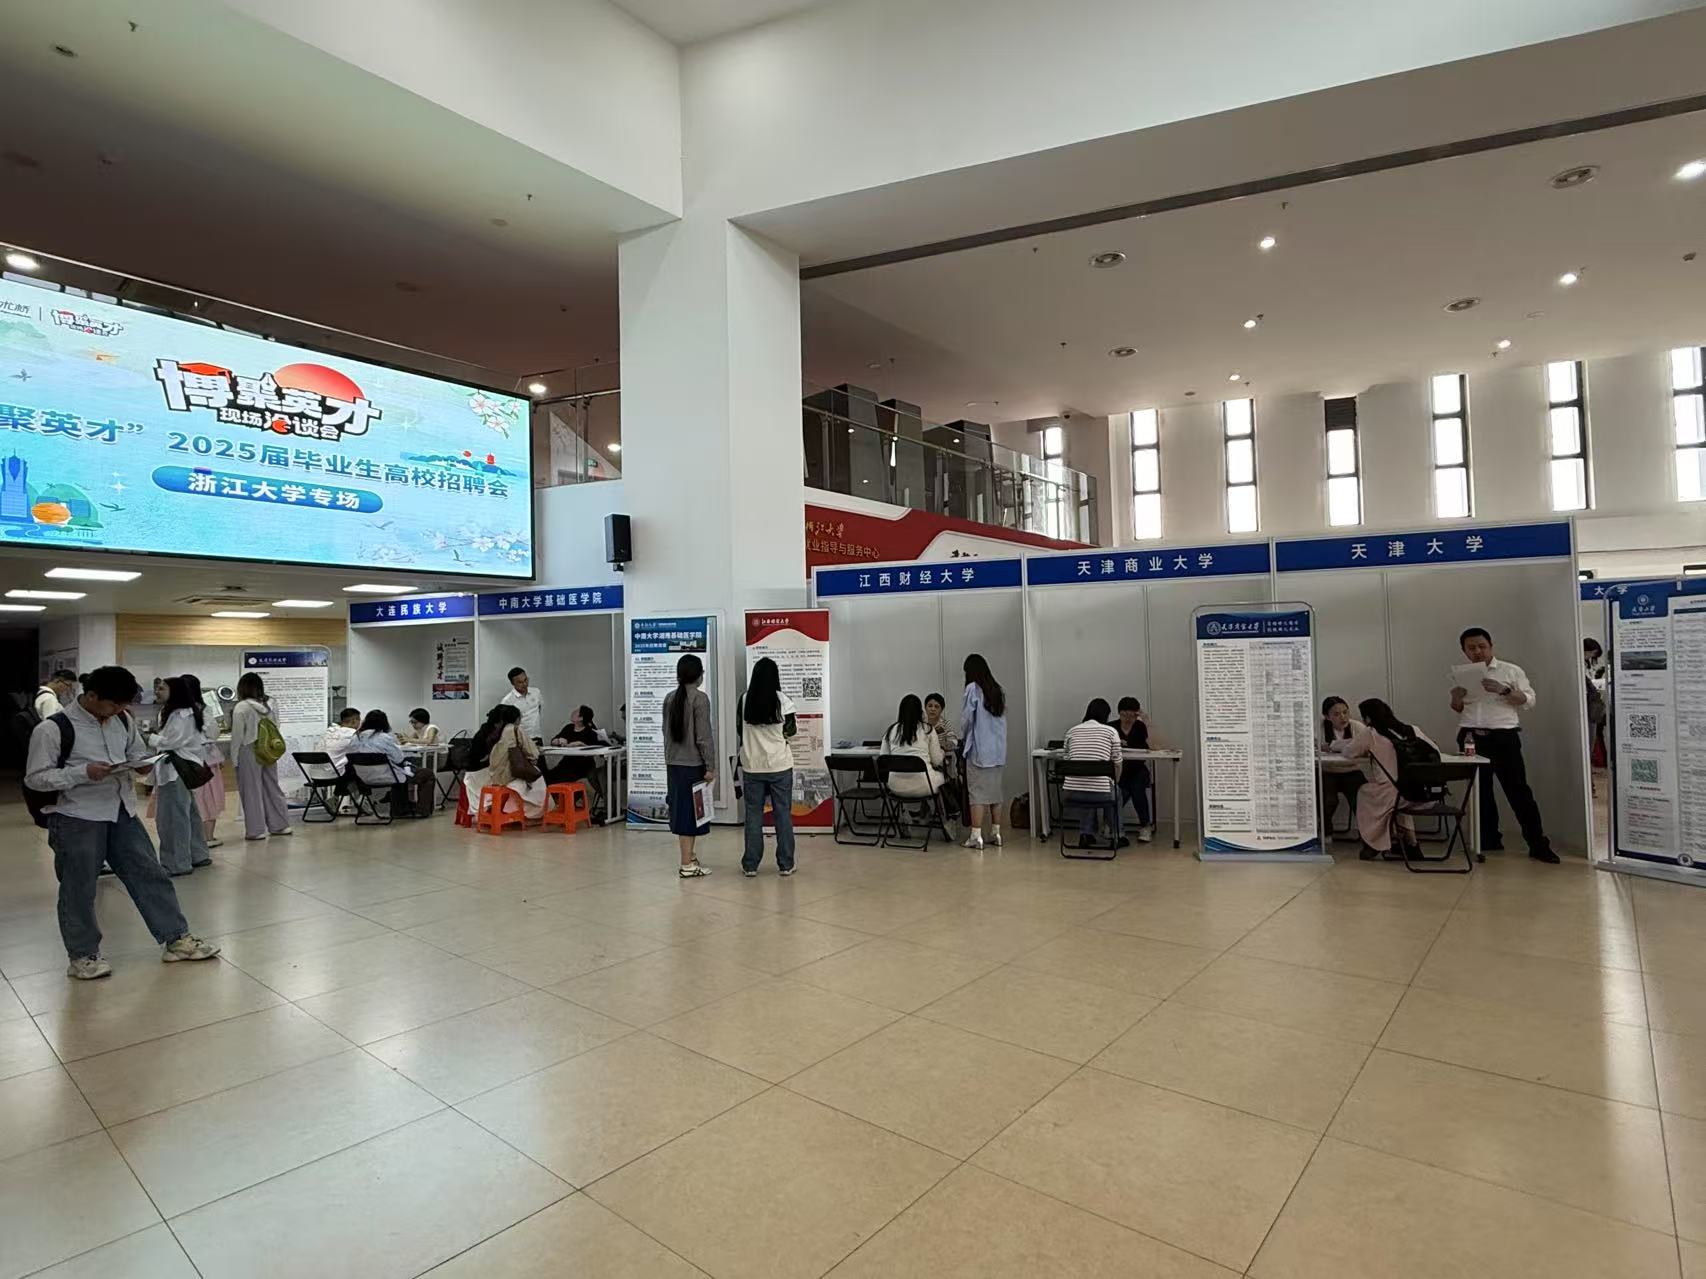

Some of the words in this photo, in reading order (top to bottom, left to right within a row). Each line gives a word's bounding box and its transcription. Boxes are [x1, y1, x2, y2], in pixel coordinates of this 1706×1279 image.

[153, 358, 382, 435] 博聚英才
[168, 431, 509, 498] 2025届毕业生高校招聘会
[187, 472, 361, 511] 浙江大学专场
[1351, 535, 1484, 560] 天津大学
[1077, 553, 1213, 576] 天津商业大学
[859, 567, 975, 588] 江西财经大学
[376, 601, 447, 617] 大连民族大学
[498, 592, 602, 609] 中南大学基础医学院
